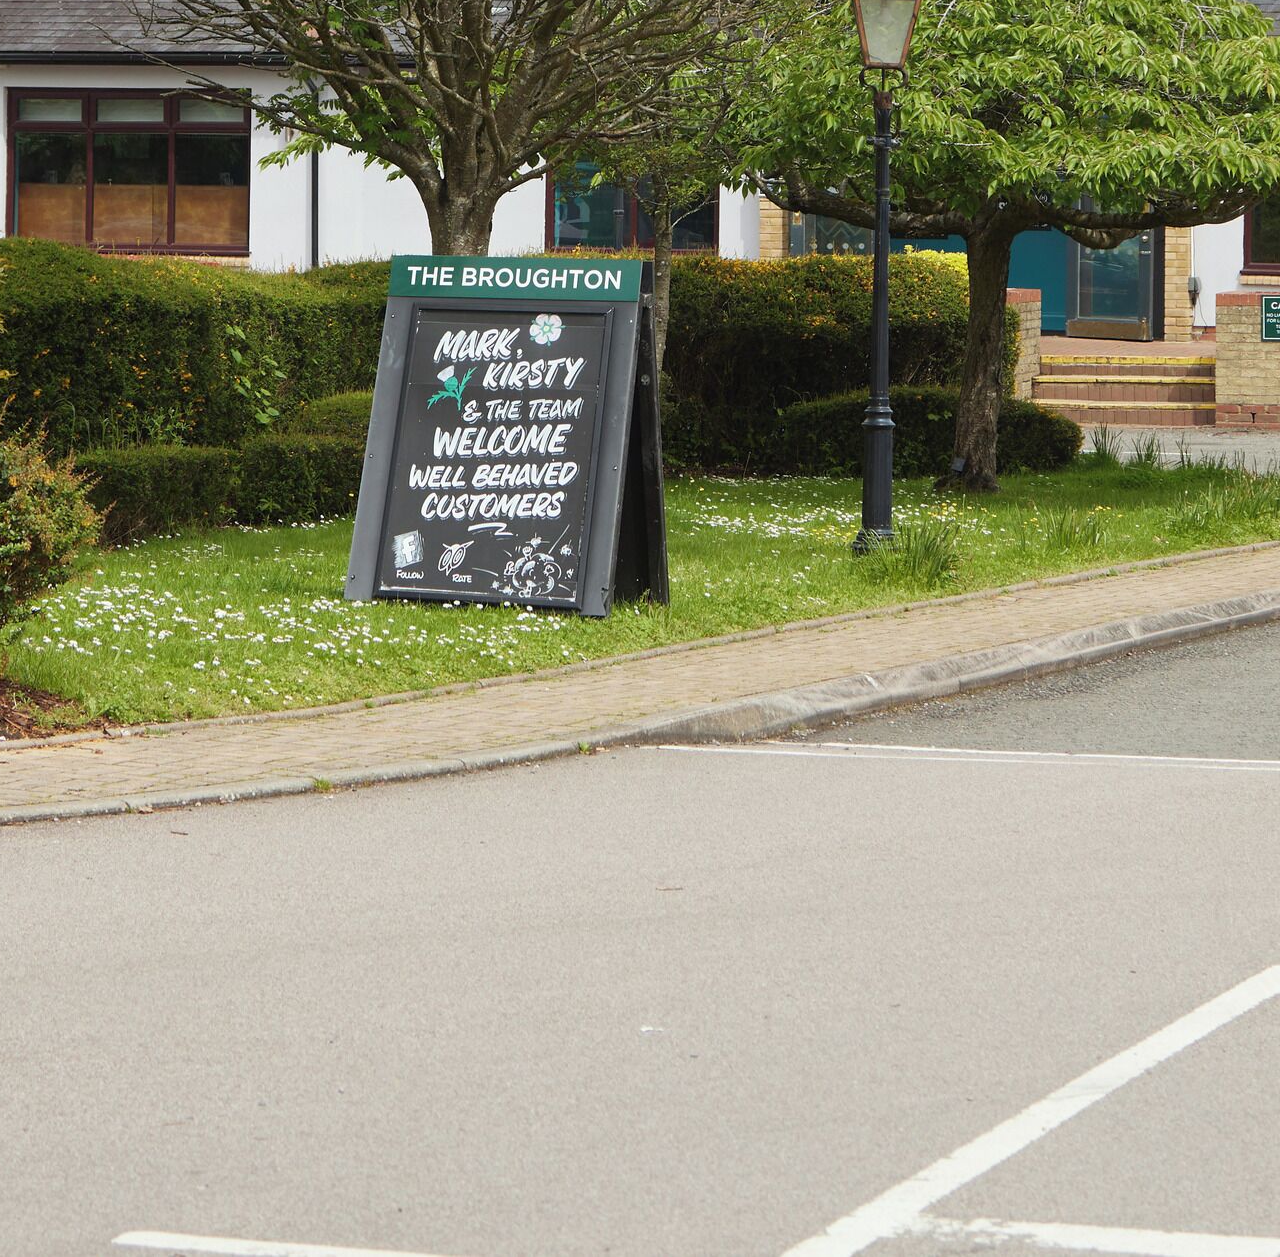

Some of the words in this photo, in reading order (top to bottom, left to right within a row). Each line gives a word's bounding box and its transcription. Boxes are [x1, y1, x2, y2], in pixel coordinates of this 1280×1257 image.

[406, 265, 455, 287] THE
[461, 267, 623, 291] BROUGHTON
[482, 357, 585, 390] KIRSTY
[463, 402, 483, 423] &
[486, 400, 523, 421] THE
[529, 398, 584, 420] TEAM
[433, 424, 573, 458] WELCOME
[408, 465, 466, 489] WELL
[471, 461, 579, 487] BEHAVED
[420, 493, 567, 520] CUSTOMERS
[396, 570, 424, 579] FOLLOW
[452, 574, 472, 583] RATE
